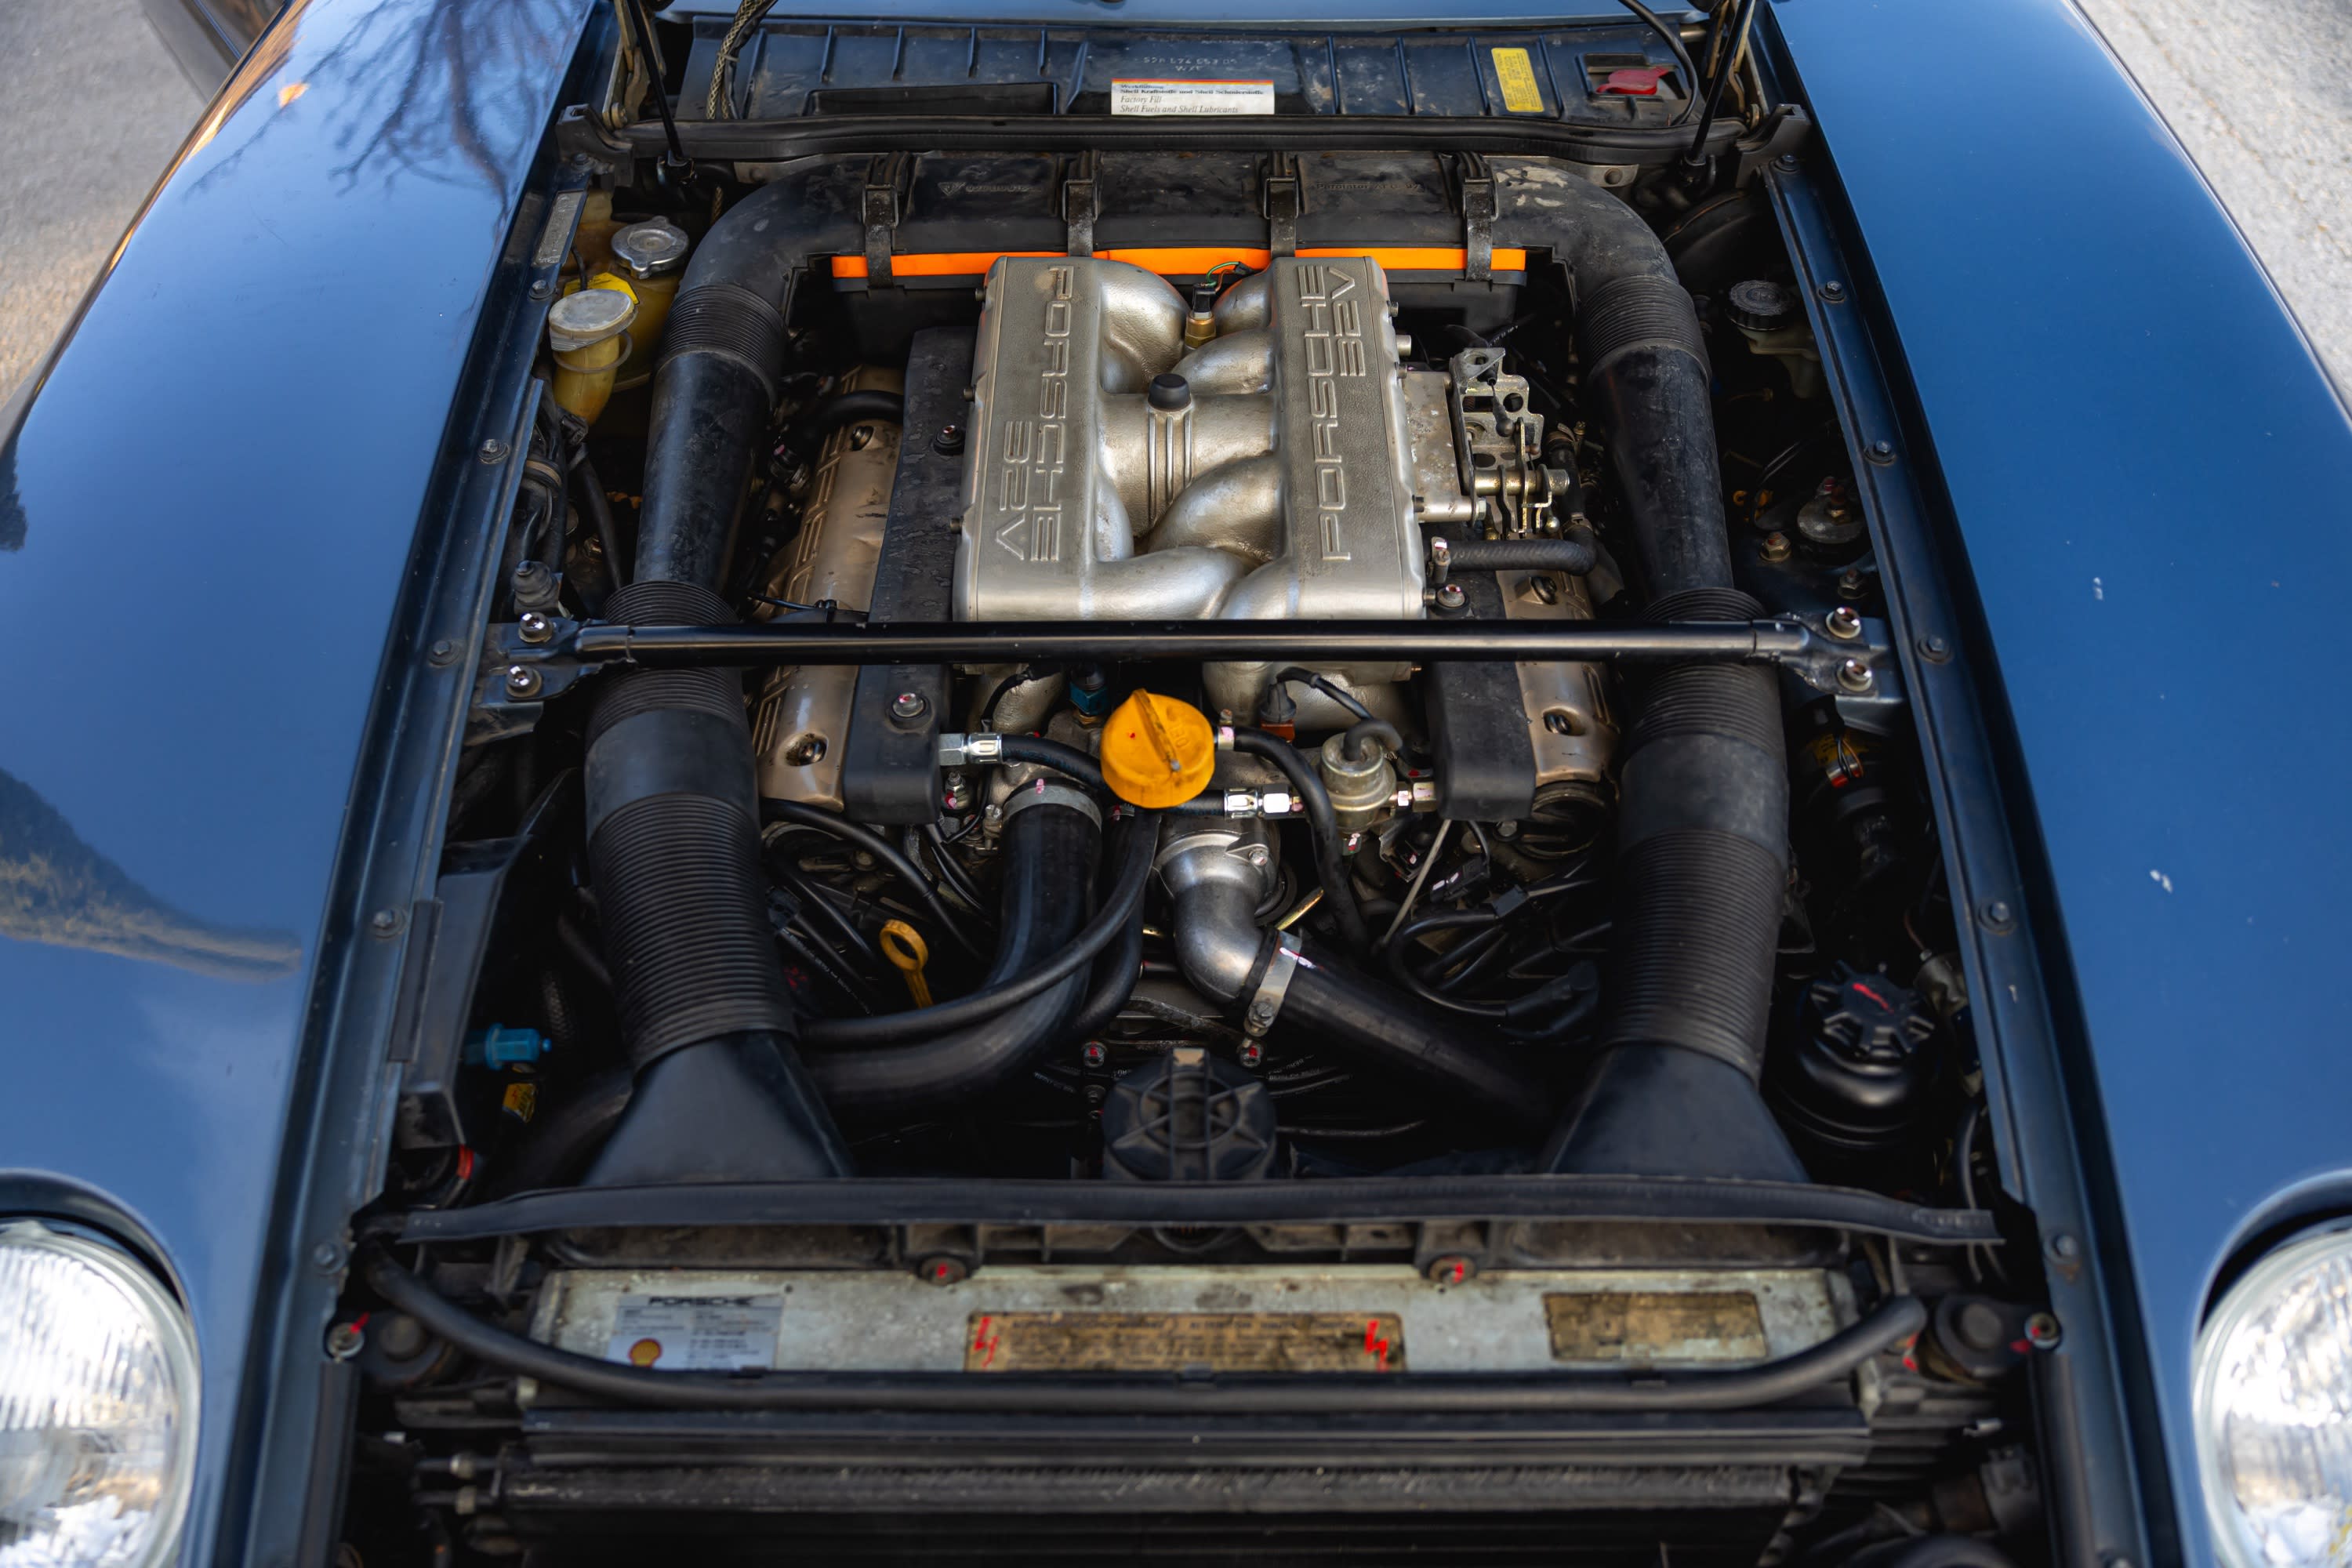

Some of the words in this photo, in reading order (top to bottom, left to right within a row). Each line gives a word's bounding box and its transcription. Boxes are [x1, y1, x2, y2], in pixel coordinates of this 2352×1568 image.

[1120, 95, 1149, 104] Factory
[1149, 94, 1163, 103] Fill
[1120, 104, 1140, 113] Shell
[1142, 104, 1160, 113] Fuels
[1327, 267, 1367, 377] 32V
[1030, 265, 1073, 561] PORSCHE
[1297, 265, 1351, 561] PORSCHE
[994, 420, 1033, 561] 32V
[648, 1296, 753, 1306] PORSCHE
